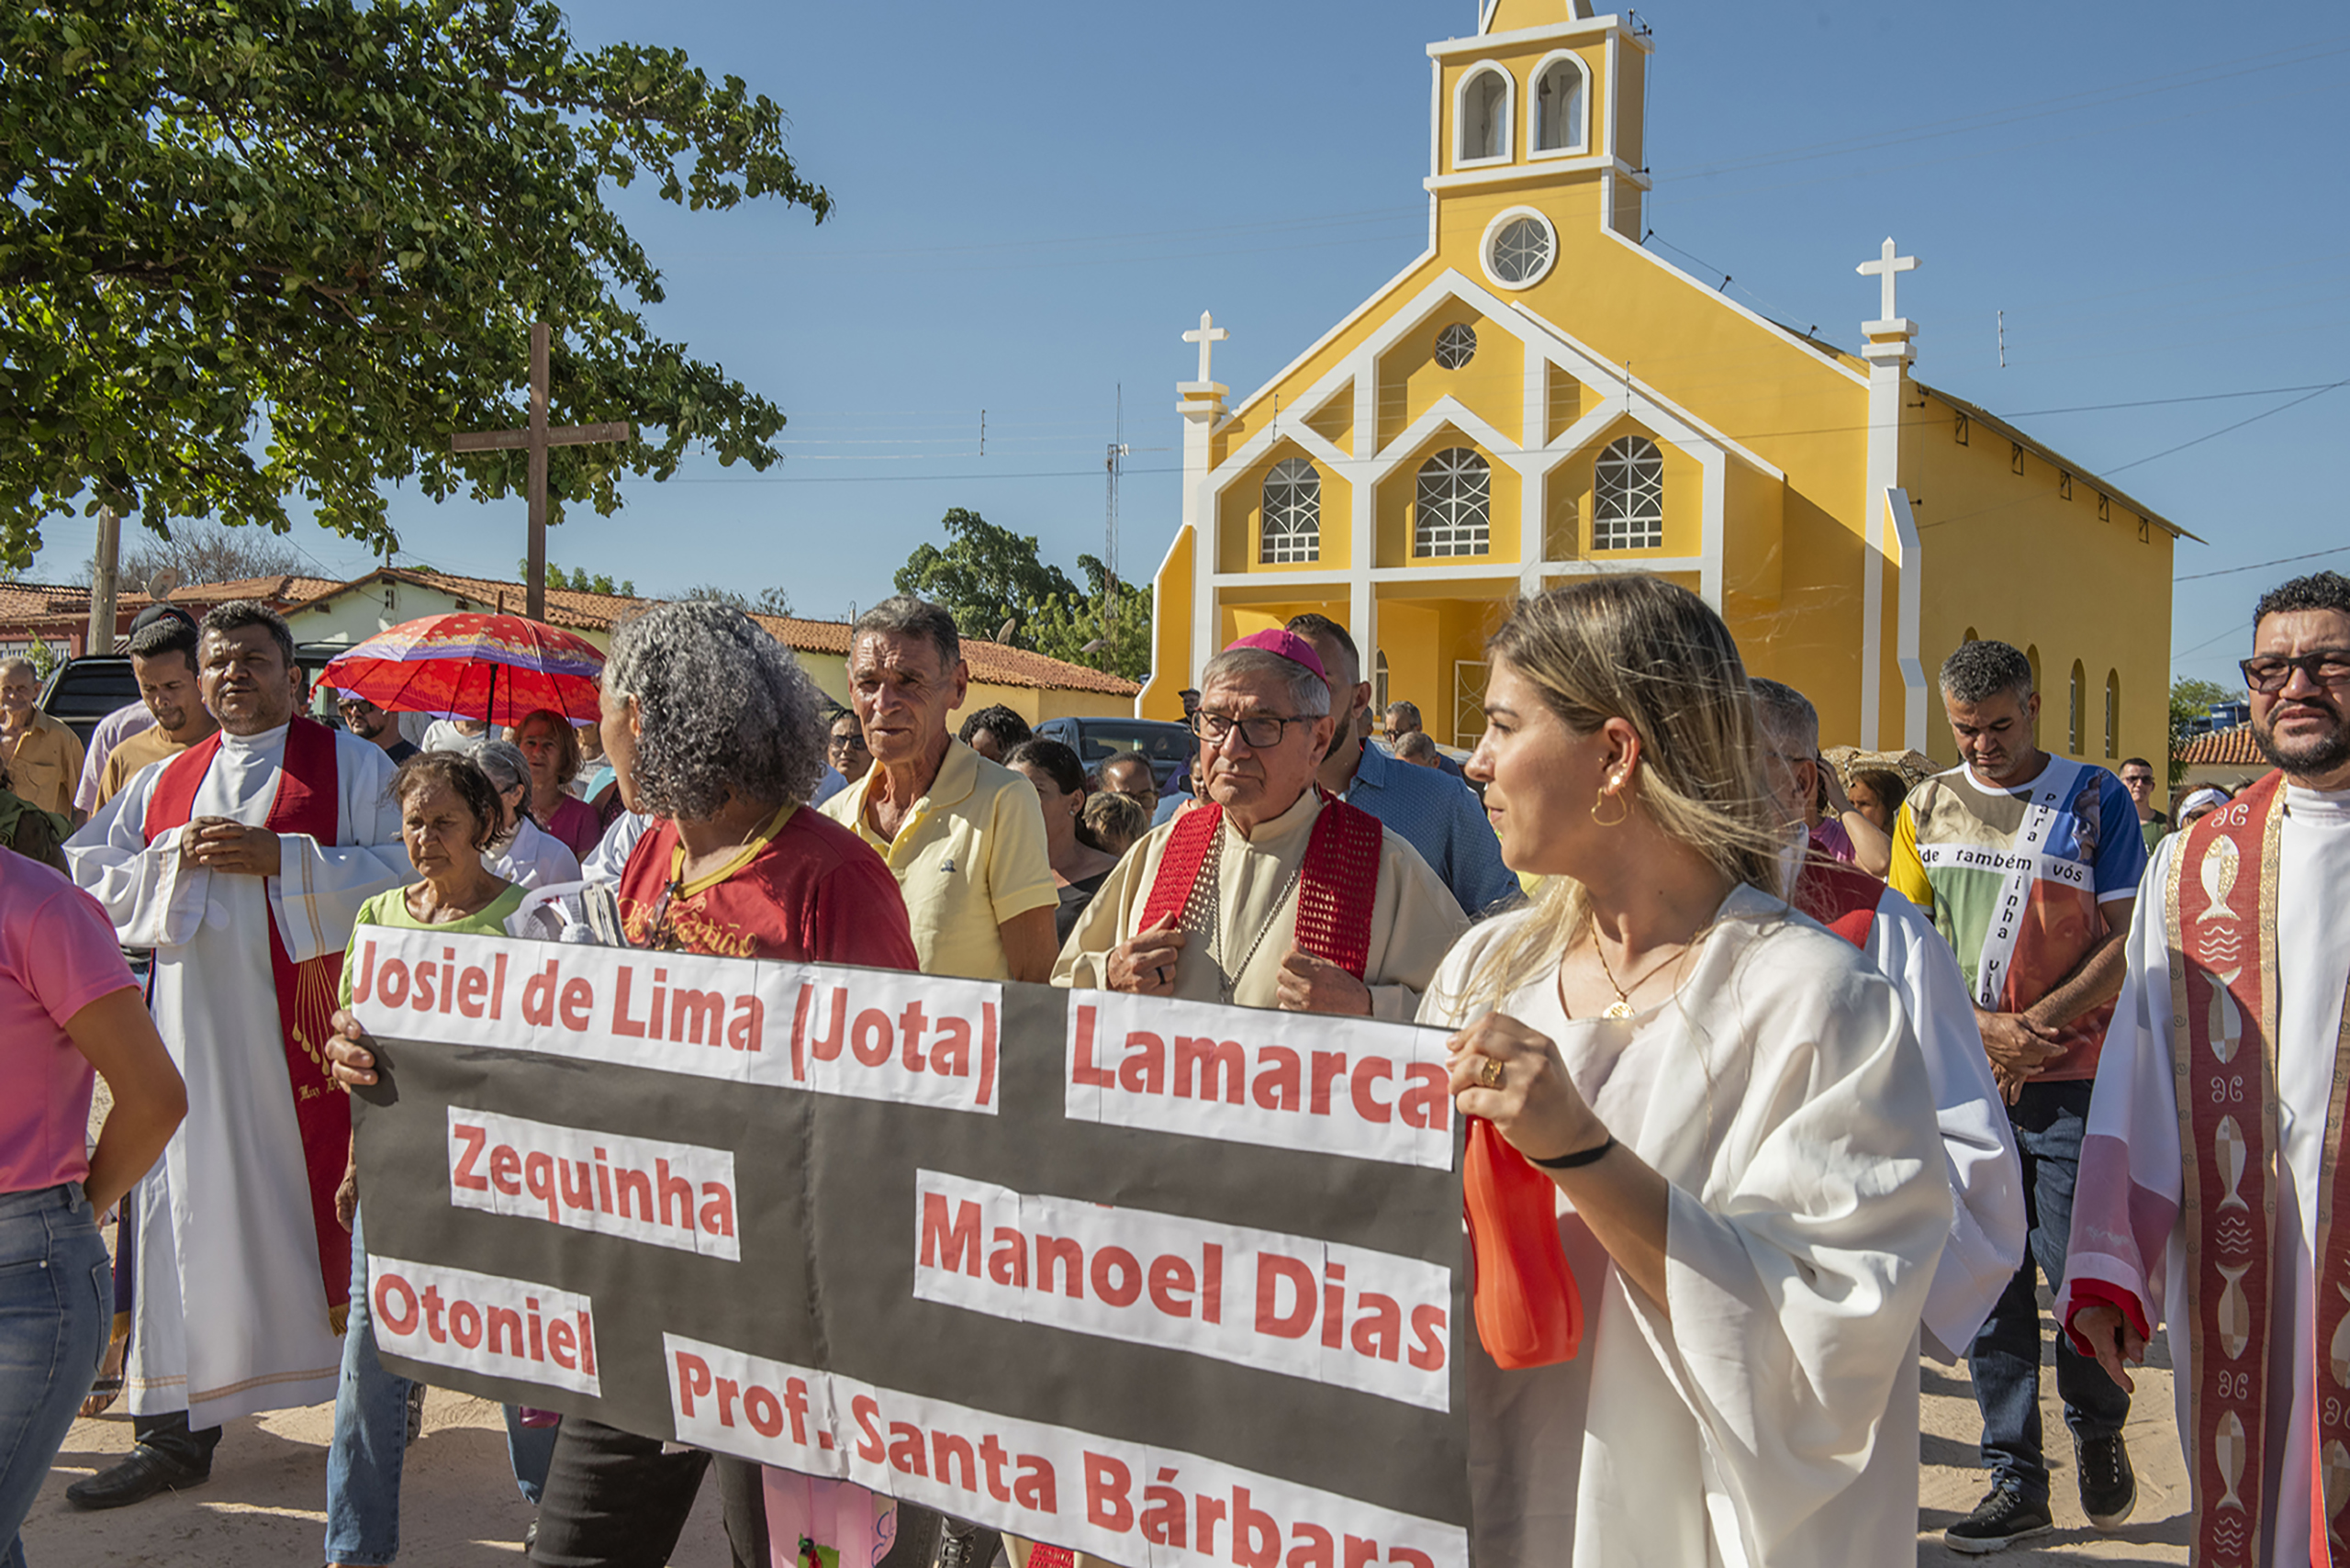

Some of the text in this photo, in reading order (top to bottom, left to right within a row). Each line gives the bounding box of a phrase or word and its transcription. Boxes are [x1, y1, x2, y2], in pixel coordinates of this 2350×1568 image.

[1955, 849, 2032, 870] também
[2053, 860, 2084, 882] vós
[352, 941, 998, 1105] Josiel de Lima (Jota)
[1072, 1004, 1450, 1132] Lamarca
[453, 1124, 734, 1238] Zequinha
[374, 1273, 596, 1376] Otoniel
[920, 1192, 1447, 1372] Manoel Dias
[675, 1350, 835, 1450] Prof.
[851, 1394, 1058, 1515] Santa
